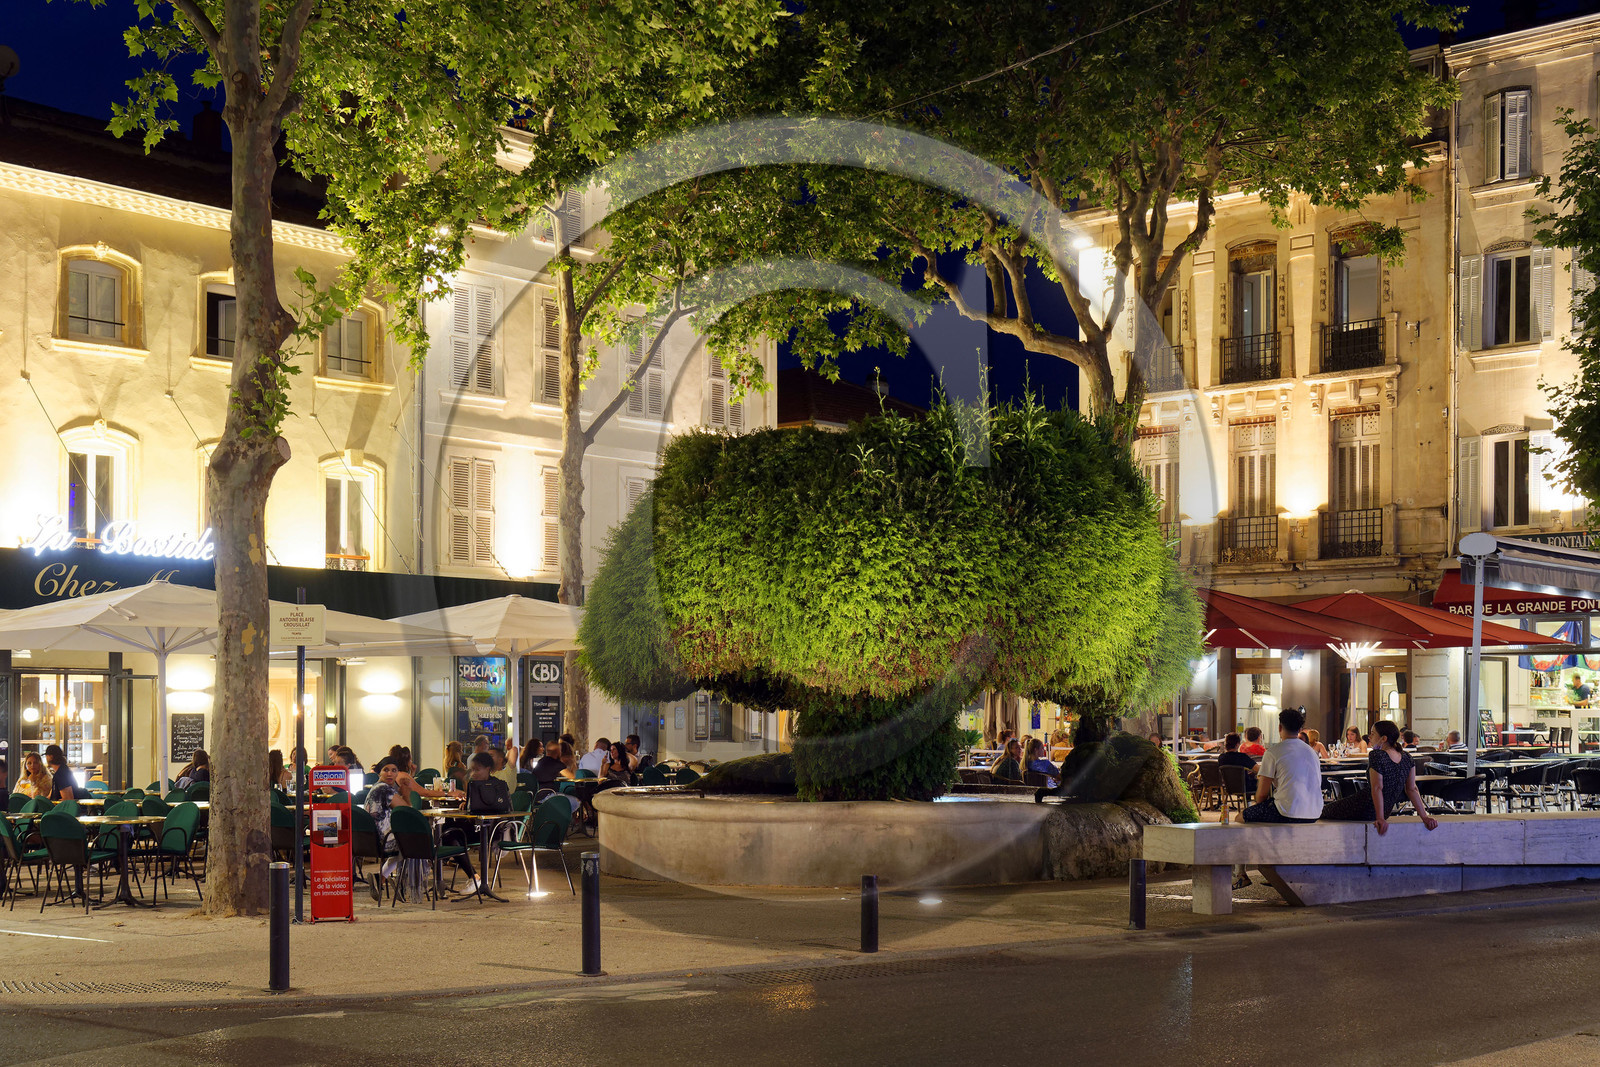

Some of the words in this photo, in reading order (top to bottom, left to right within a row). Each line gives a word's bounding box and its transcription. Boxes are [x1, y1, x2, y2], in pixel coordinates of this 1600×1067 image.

[100, 520, 214, 560] Bastide
[1449, 604, 1473, 615] BAR
[1497, 602, 1513, 613] LA
[1516, 600, 1566, 612] GRANDE
[532, 663, 560, 682] CBD
[314, 771, 345, 780] Régional
